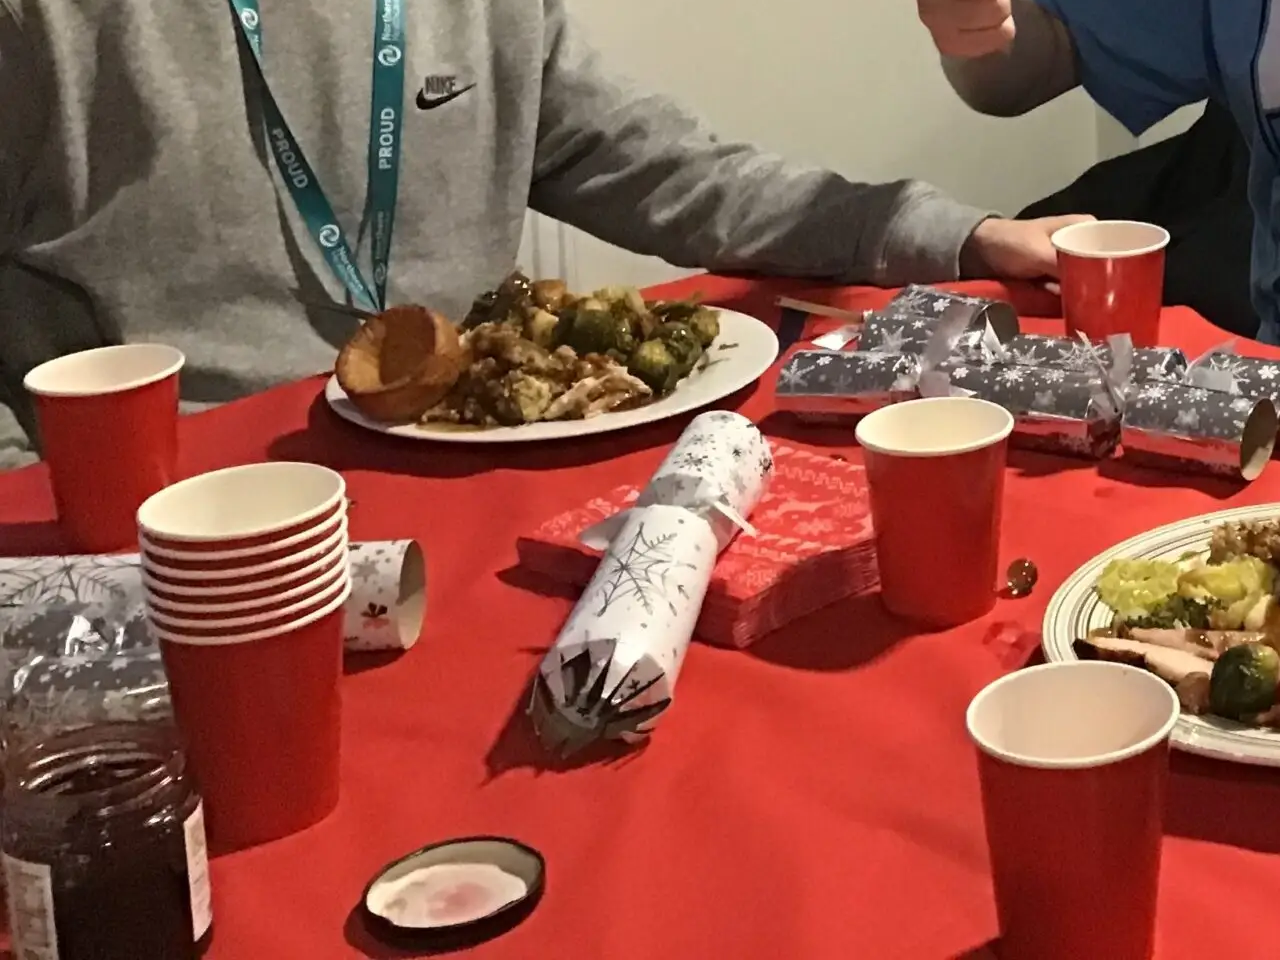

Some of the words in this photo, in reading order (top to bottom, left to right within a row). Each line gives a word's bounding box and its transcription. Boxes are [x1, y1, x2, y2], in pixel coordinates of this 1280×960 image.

[425, 74, 456, 95] NIKE
[272, 127, 309, 190] PROUD
[378, 106, 396, 170] PROUD
